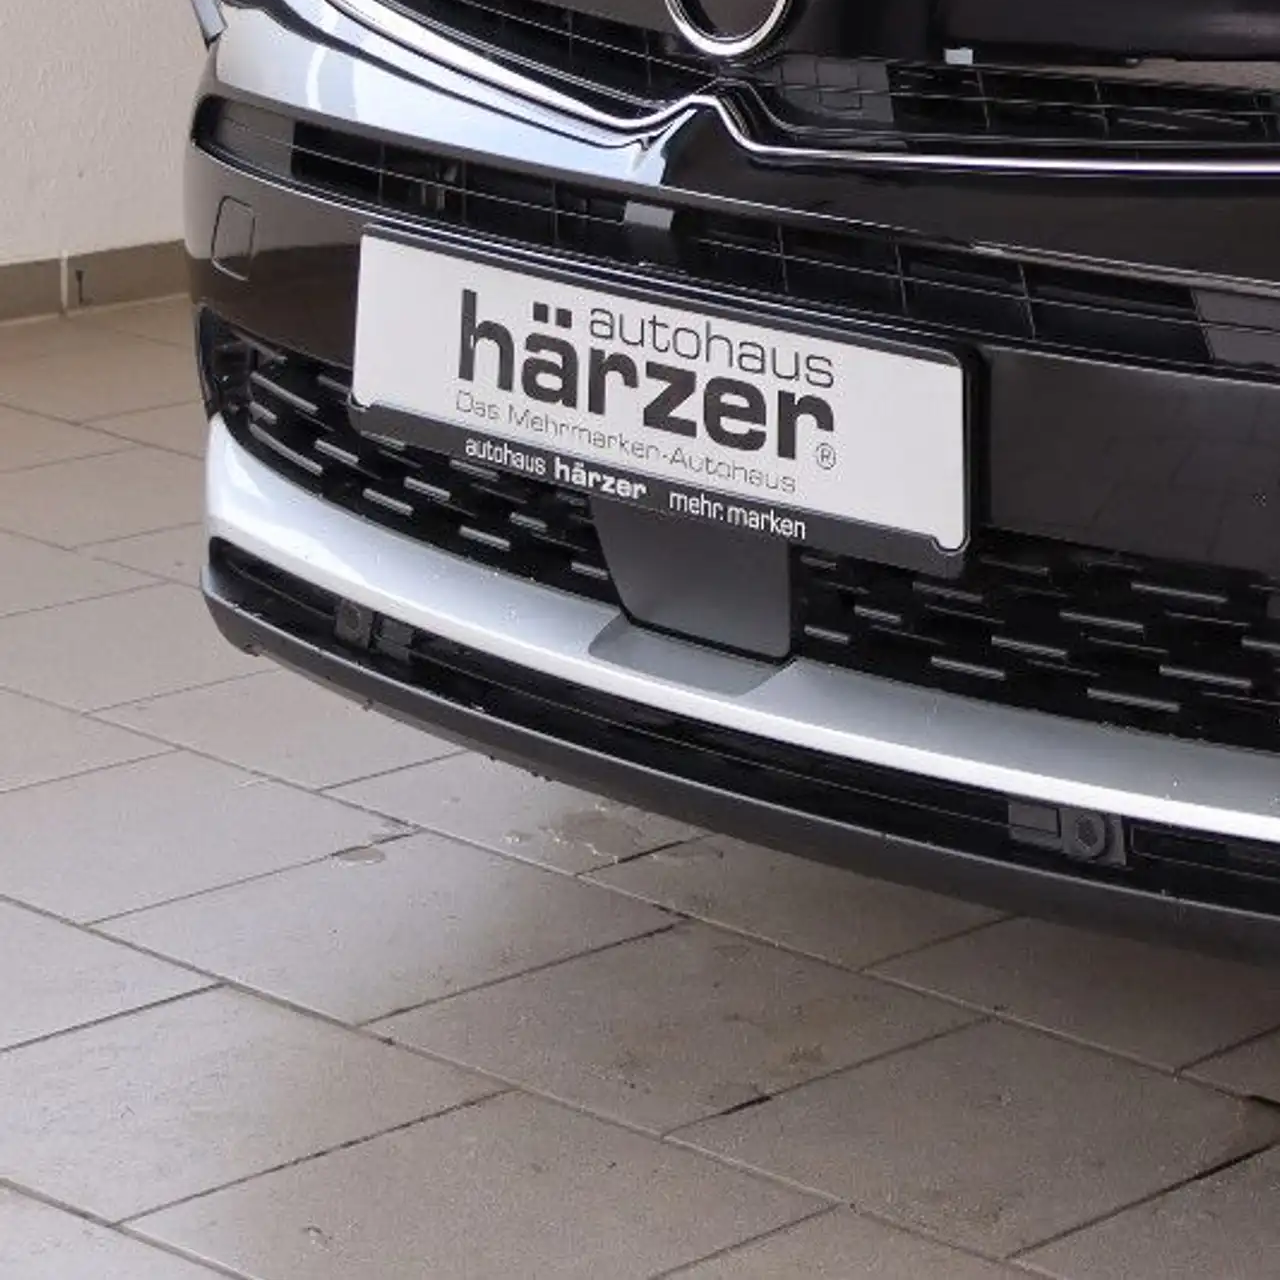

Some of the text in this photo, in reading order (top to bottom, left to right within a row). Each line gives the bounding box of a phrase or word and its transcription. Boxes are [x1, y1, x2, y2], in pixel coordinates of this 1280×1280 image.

[458, 288, 835, 460] härzer
[589, 307, 834, 389] autohaus
[456, 390, 796, 493] Das Mehrmarken-Autohaus
[465, 437, 547, 475] autohaus
[554, 457, 647, 500] härzer
